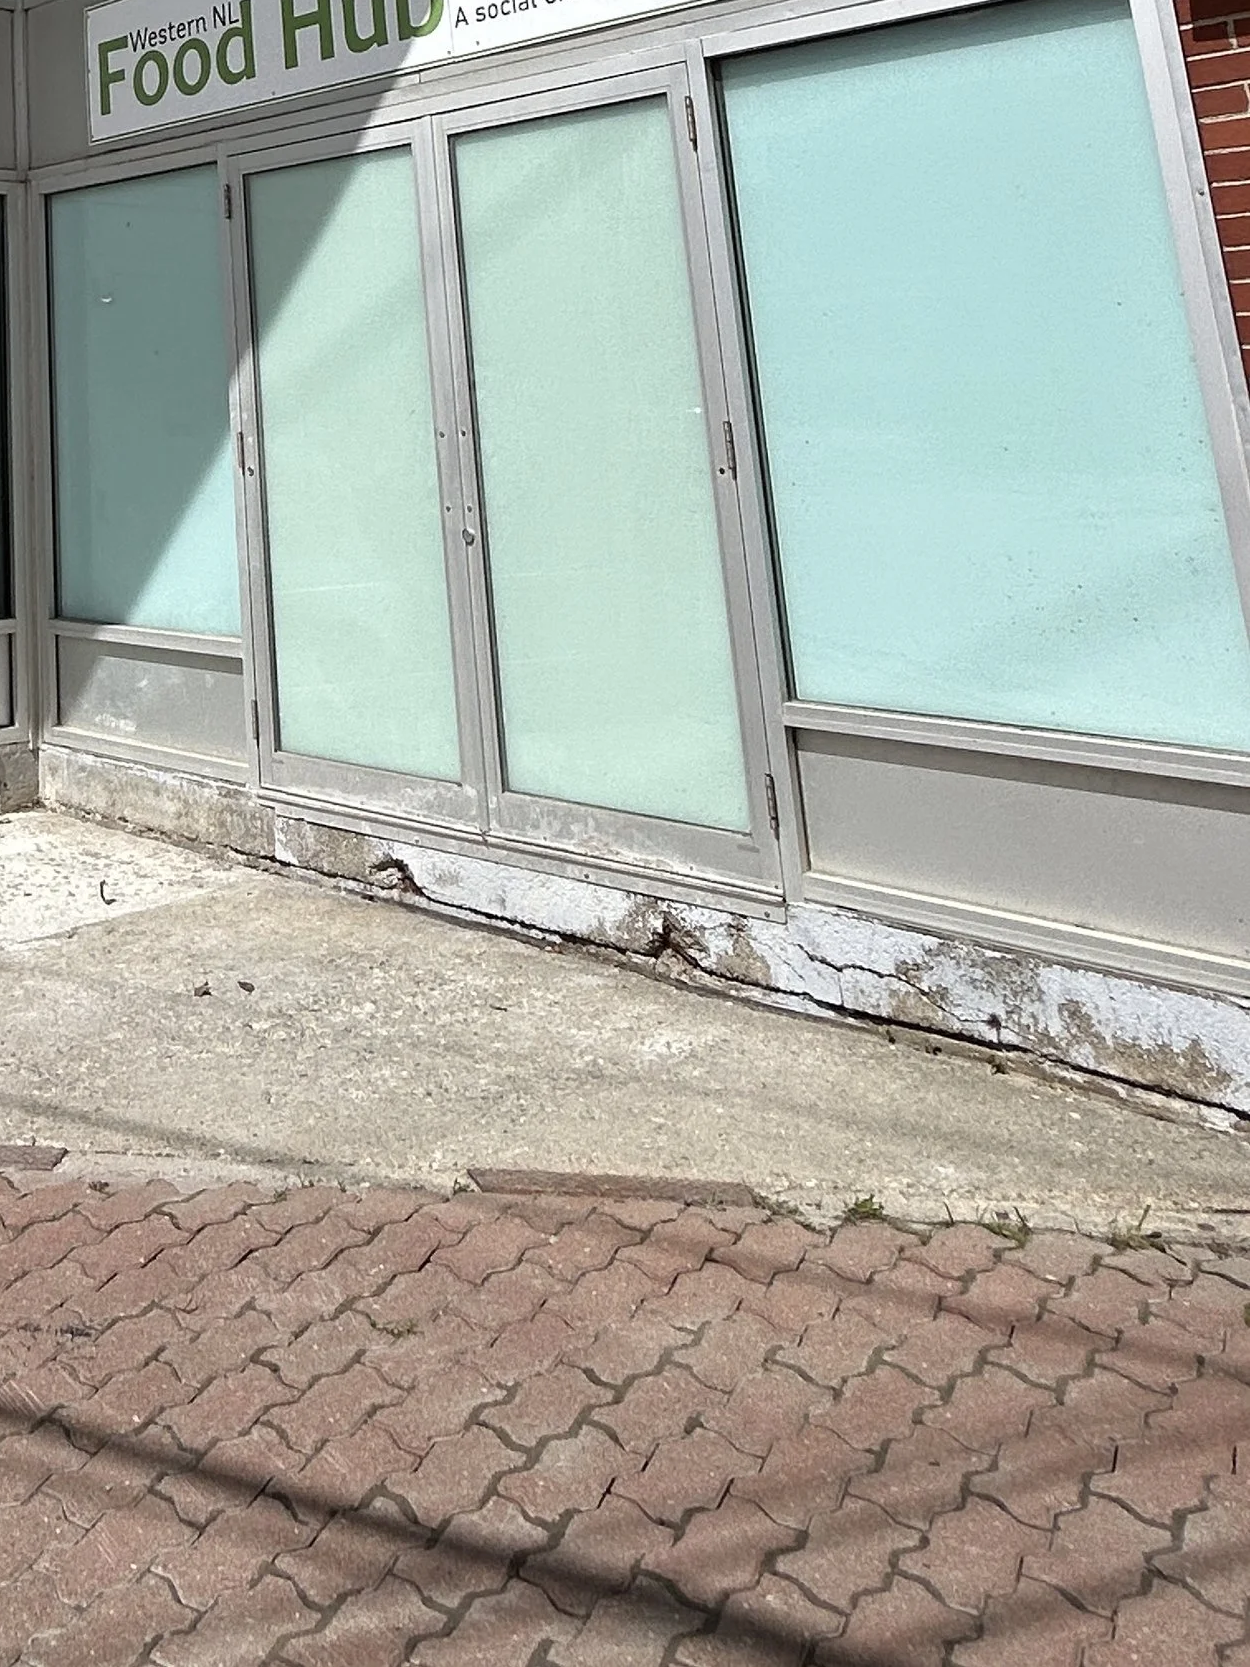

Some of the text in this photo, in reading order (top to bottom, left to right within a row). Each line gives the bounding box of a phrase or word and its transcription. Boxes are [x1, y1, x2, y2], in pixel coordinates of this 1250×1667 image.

[128, 1, 240, 53] Western NL
[454, 6, 470, 29] A
